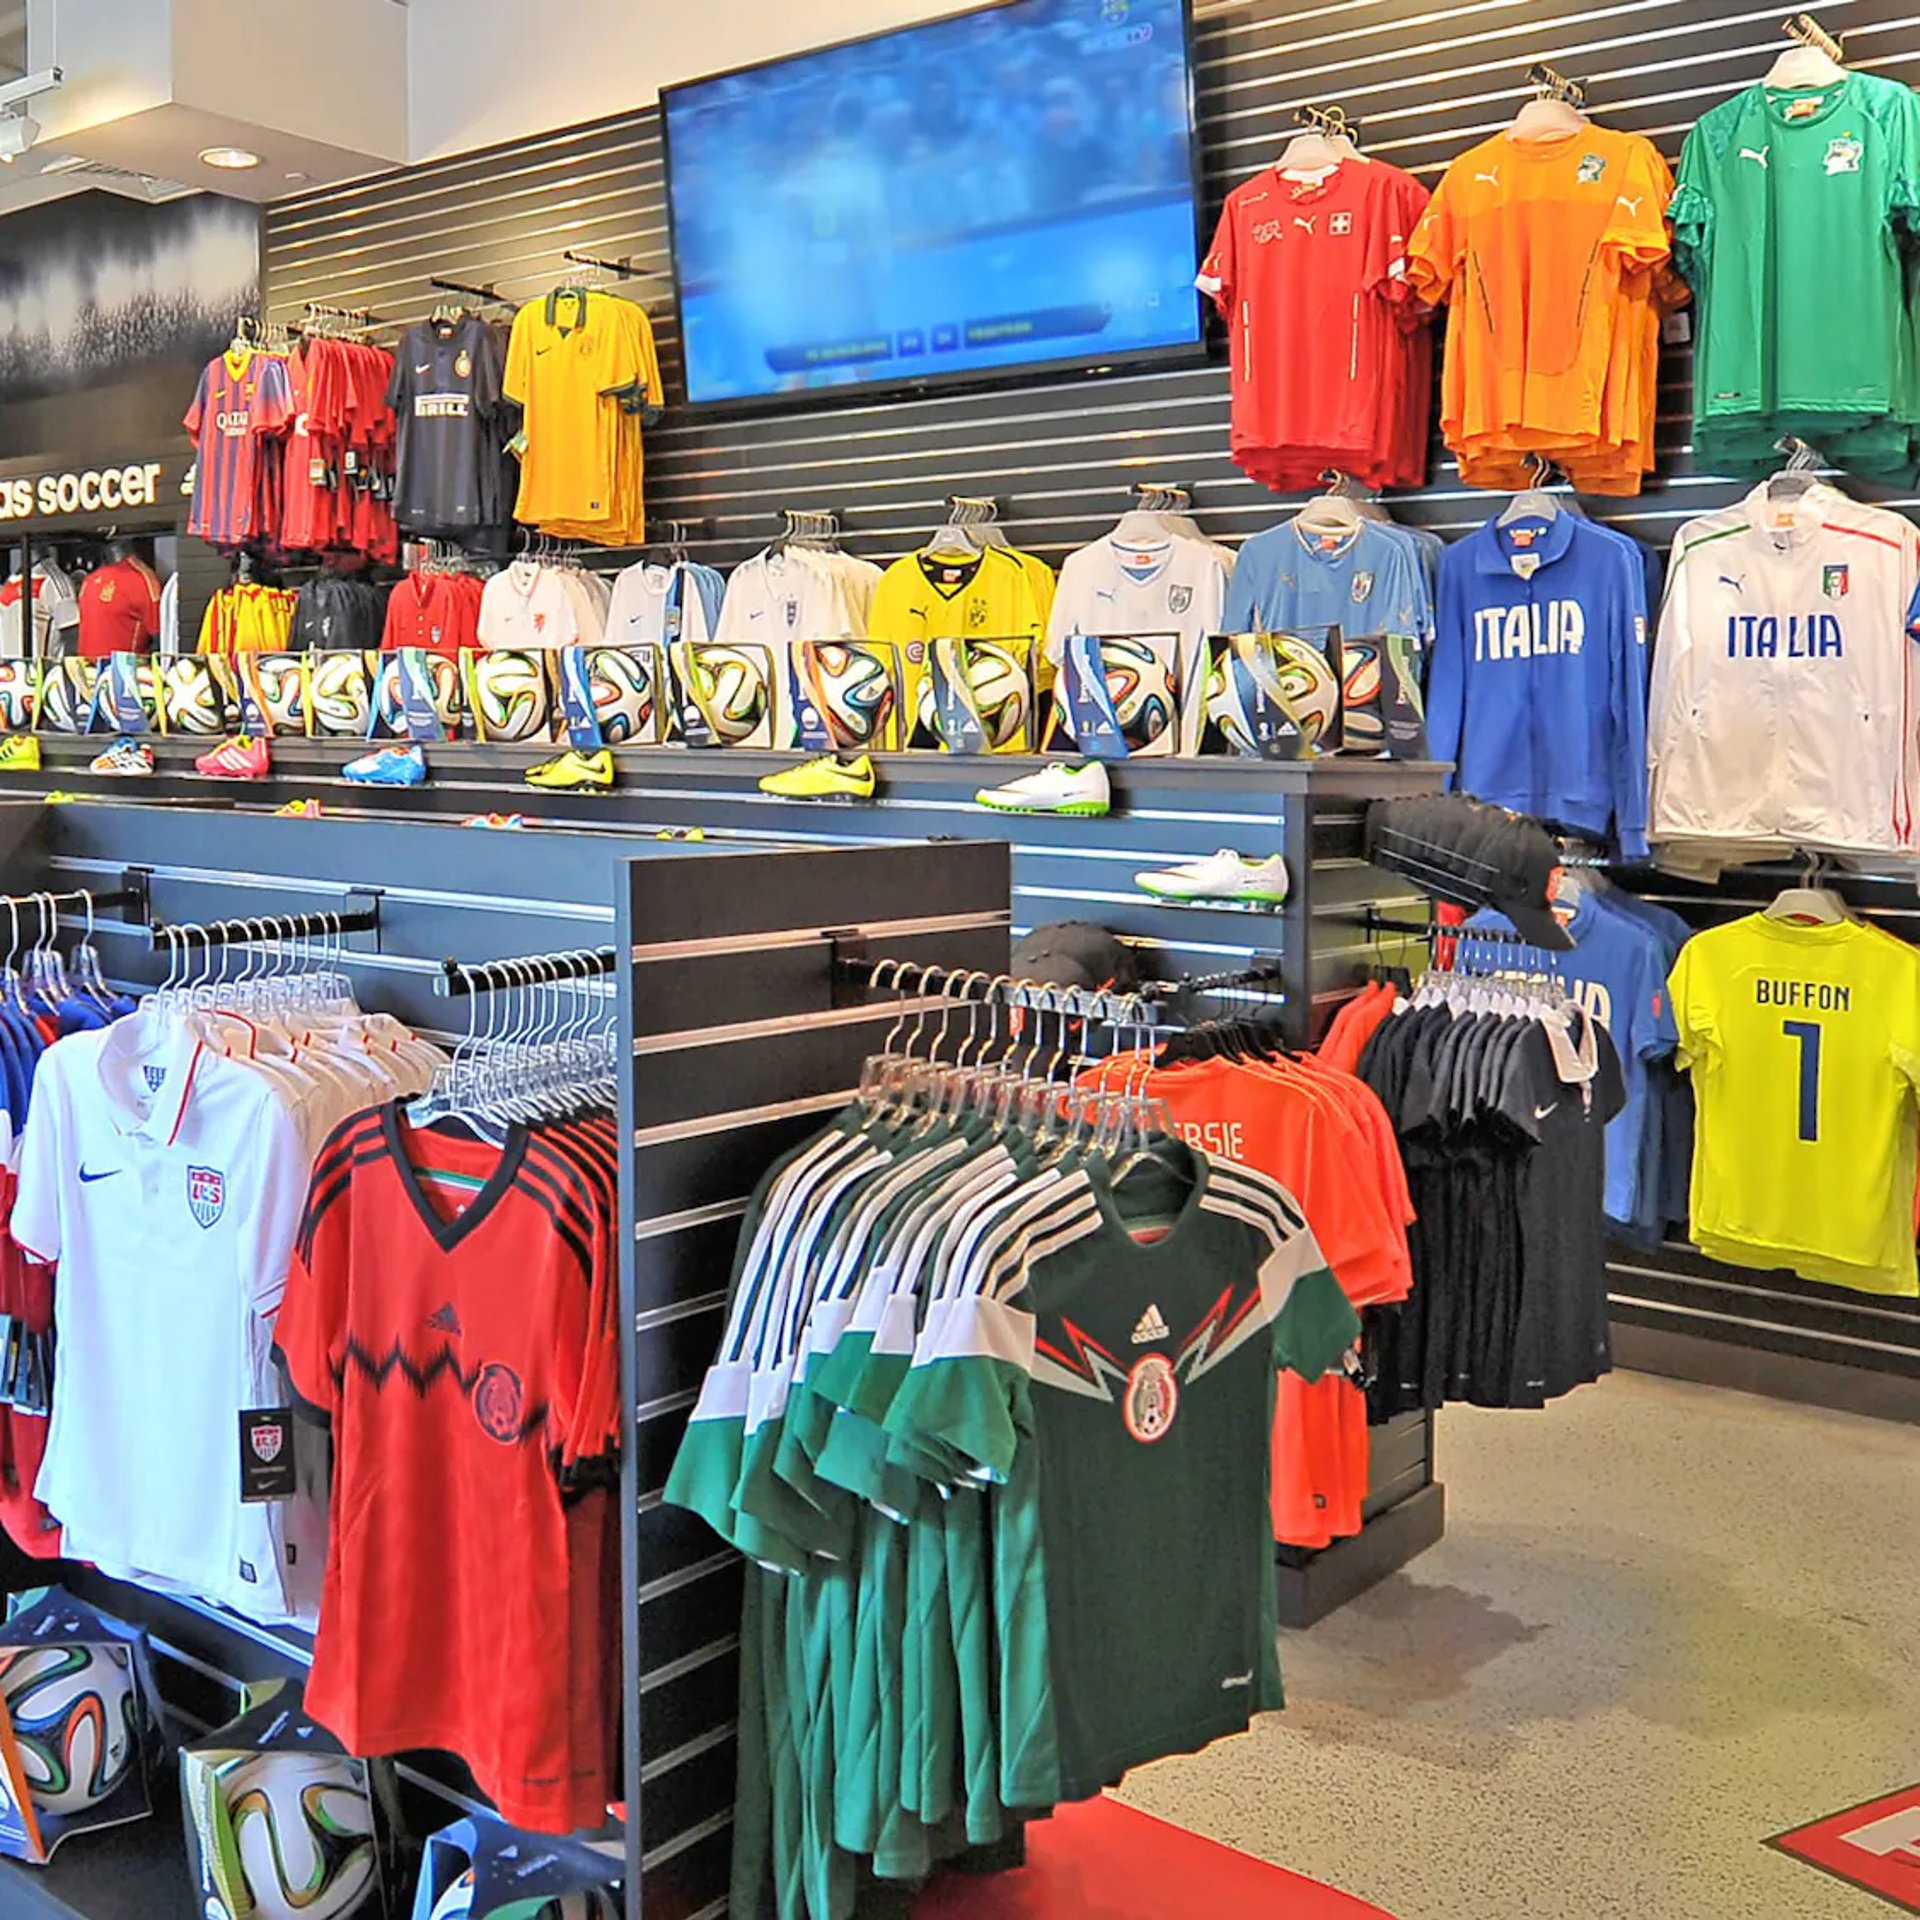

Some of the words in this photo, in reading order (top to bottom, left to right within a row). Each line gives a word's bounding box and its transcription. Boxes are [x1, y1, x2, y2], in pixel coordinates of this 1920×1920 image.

[38, 463, 161, 515] soccer
[1474, 600, 1585, 662] ITALIA
[1728, 615, 1843, 658] ITALIA
[1757, 979, 1850, 1012] BUFFON
[1783, 1020, 1821, 1142] 1
